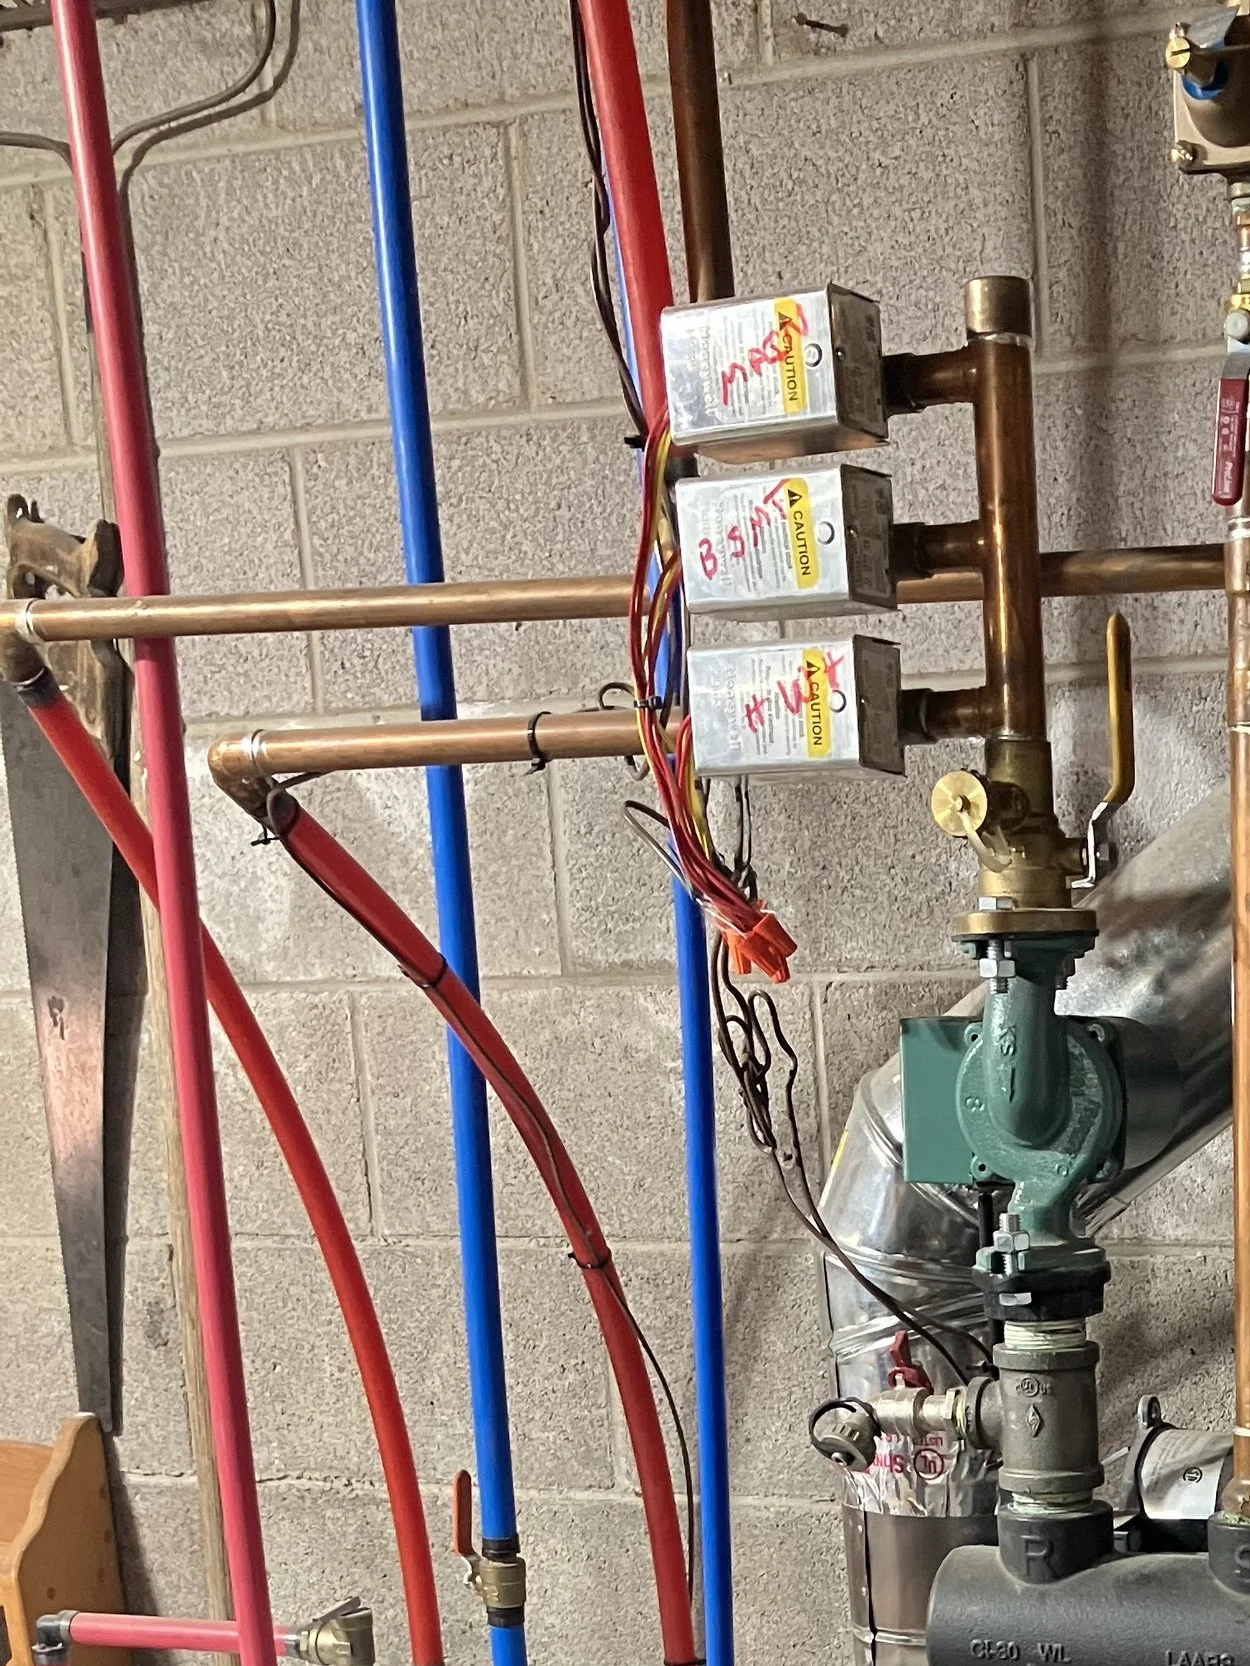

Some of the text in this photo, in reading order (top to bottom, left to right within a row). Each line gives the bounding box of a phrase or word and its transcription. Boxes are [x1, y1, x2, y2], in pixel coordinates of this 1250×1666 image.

[781, 333, 799, 403] CAUTION
[698, 479, 789, 581] BSMT
[793, 510, 812, 576] CAUTION
[809, 681, 824, 747] CAUTION
[1021, 1535, 1055, 1576] R
